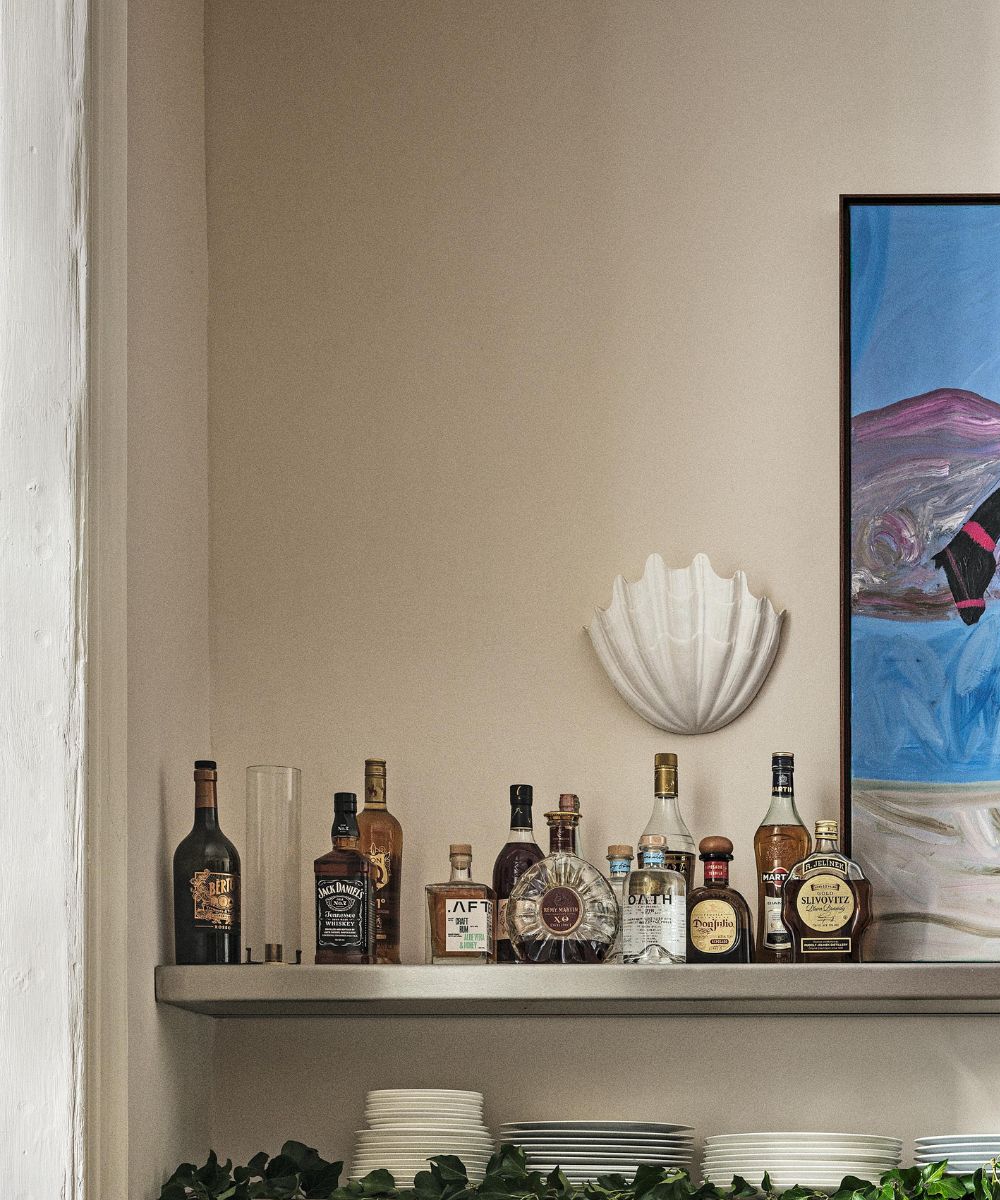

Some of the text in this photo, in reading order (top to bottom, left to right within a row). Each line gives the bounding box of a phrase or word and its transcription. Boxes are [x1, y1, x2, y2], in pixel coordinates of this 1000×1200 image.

[318, 882, 364, 900] JACK DANIEL'S
[801, 896, 850, 905] SLIVOVITZ
